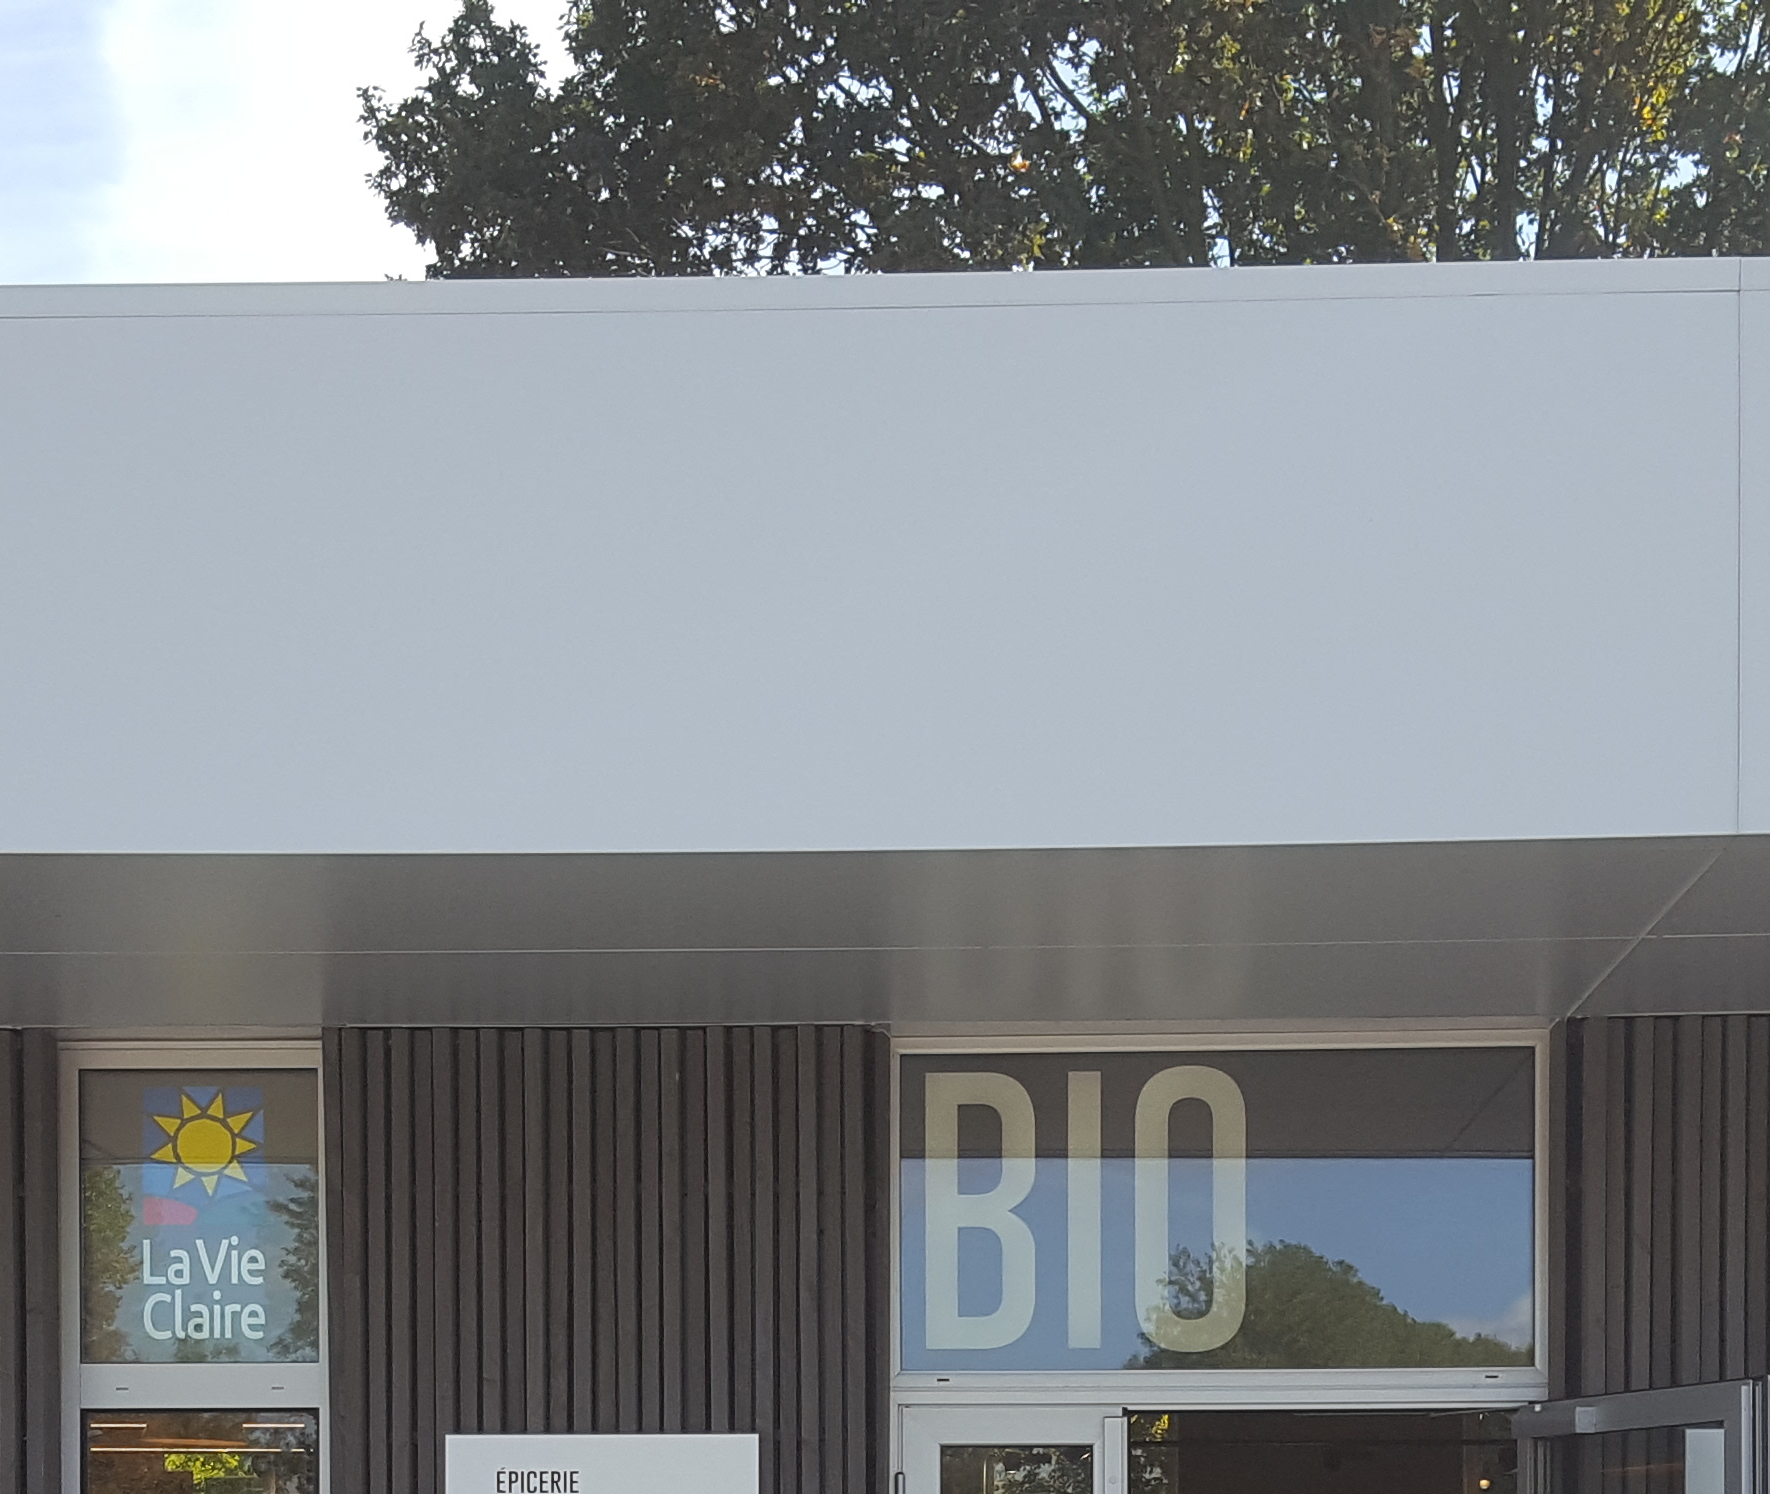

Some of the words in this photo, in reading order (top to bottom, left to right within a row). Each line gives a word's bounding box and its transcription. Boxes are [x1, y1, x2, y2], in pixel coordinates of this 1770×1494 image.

[924, 1064, 1247, 1352] BIO
[143, 1239, 190, 1285] La
[196, 1236, 266, 1285] Vie
[143, 1289, 266, 1341] Claire
[495, 1467, 579, 1493] ÉPICERIE
